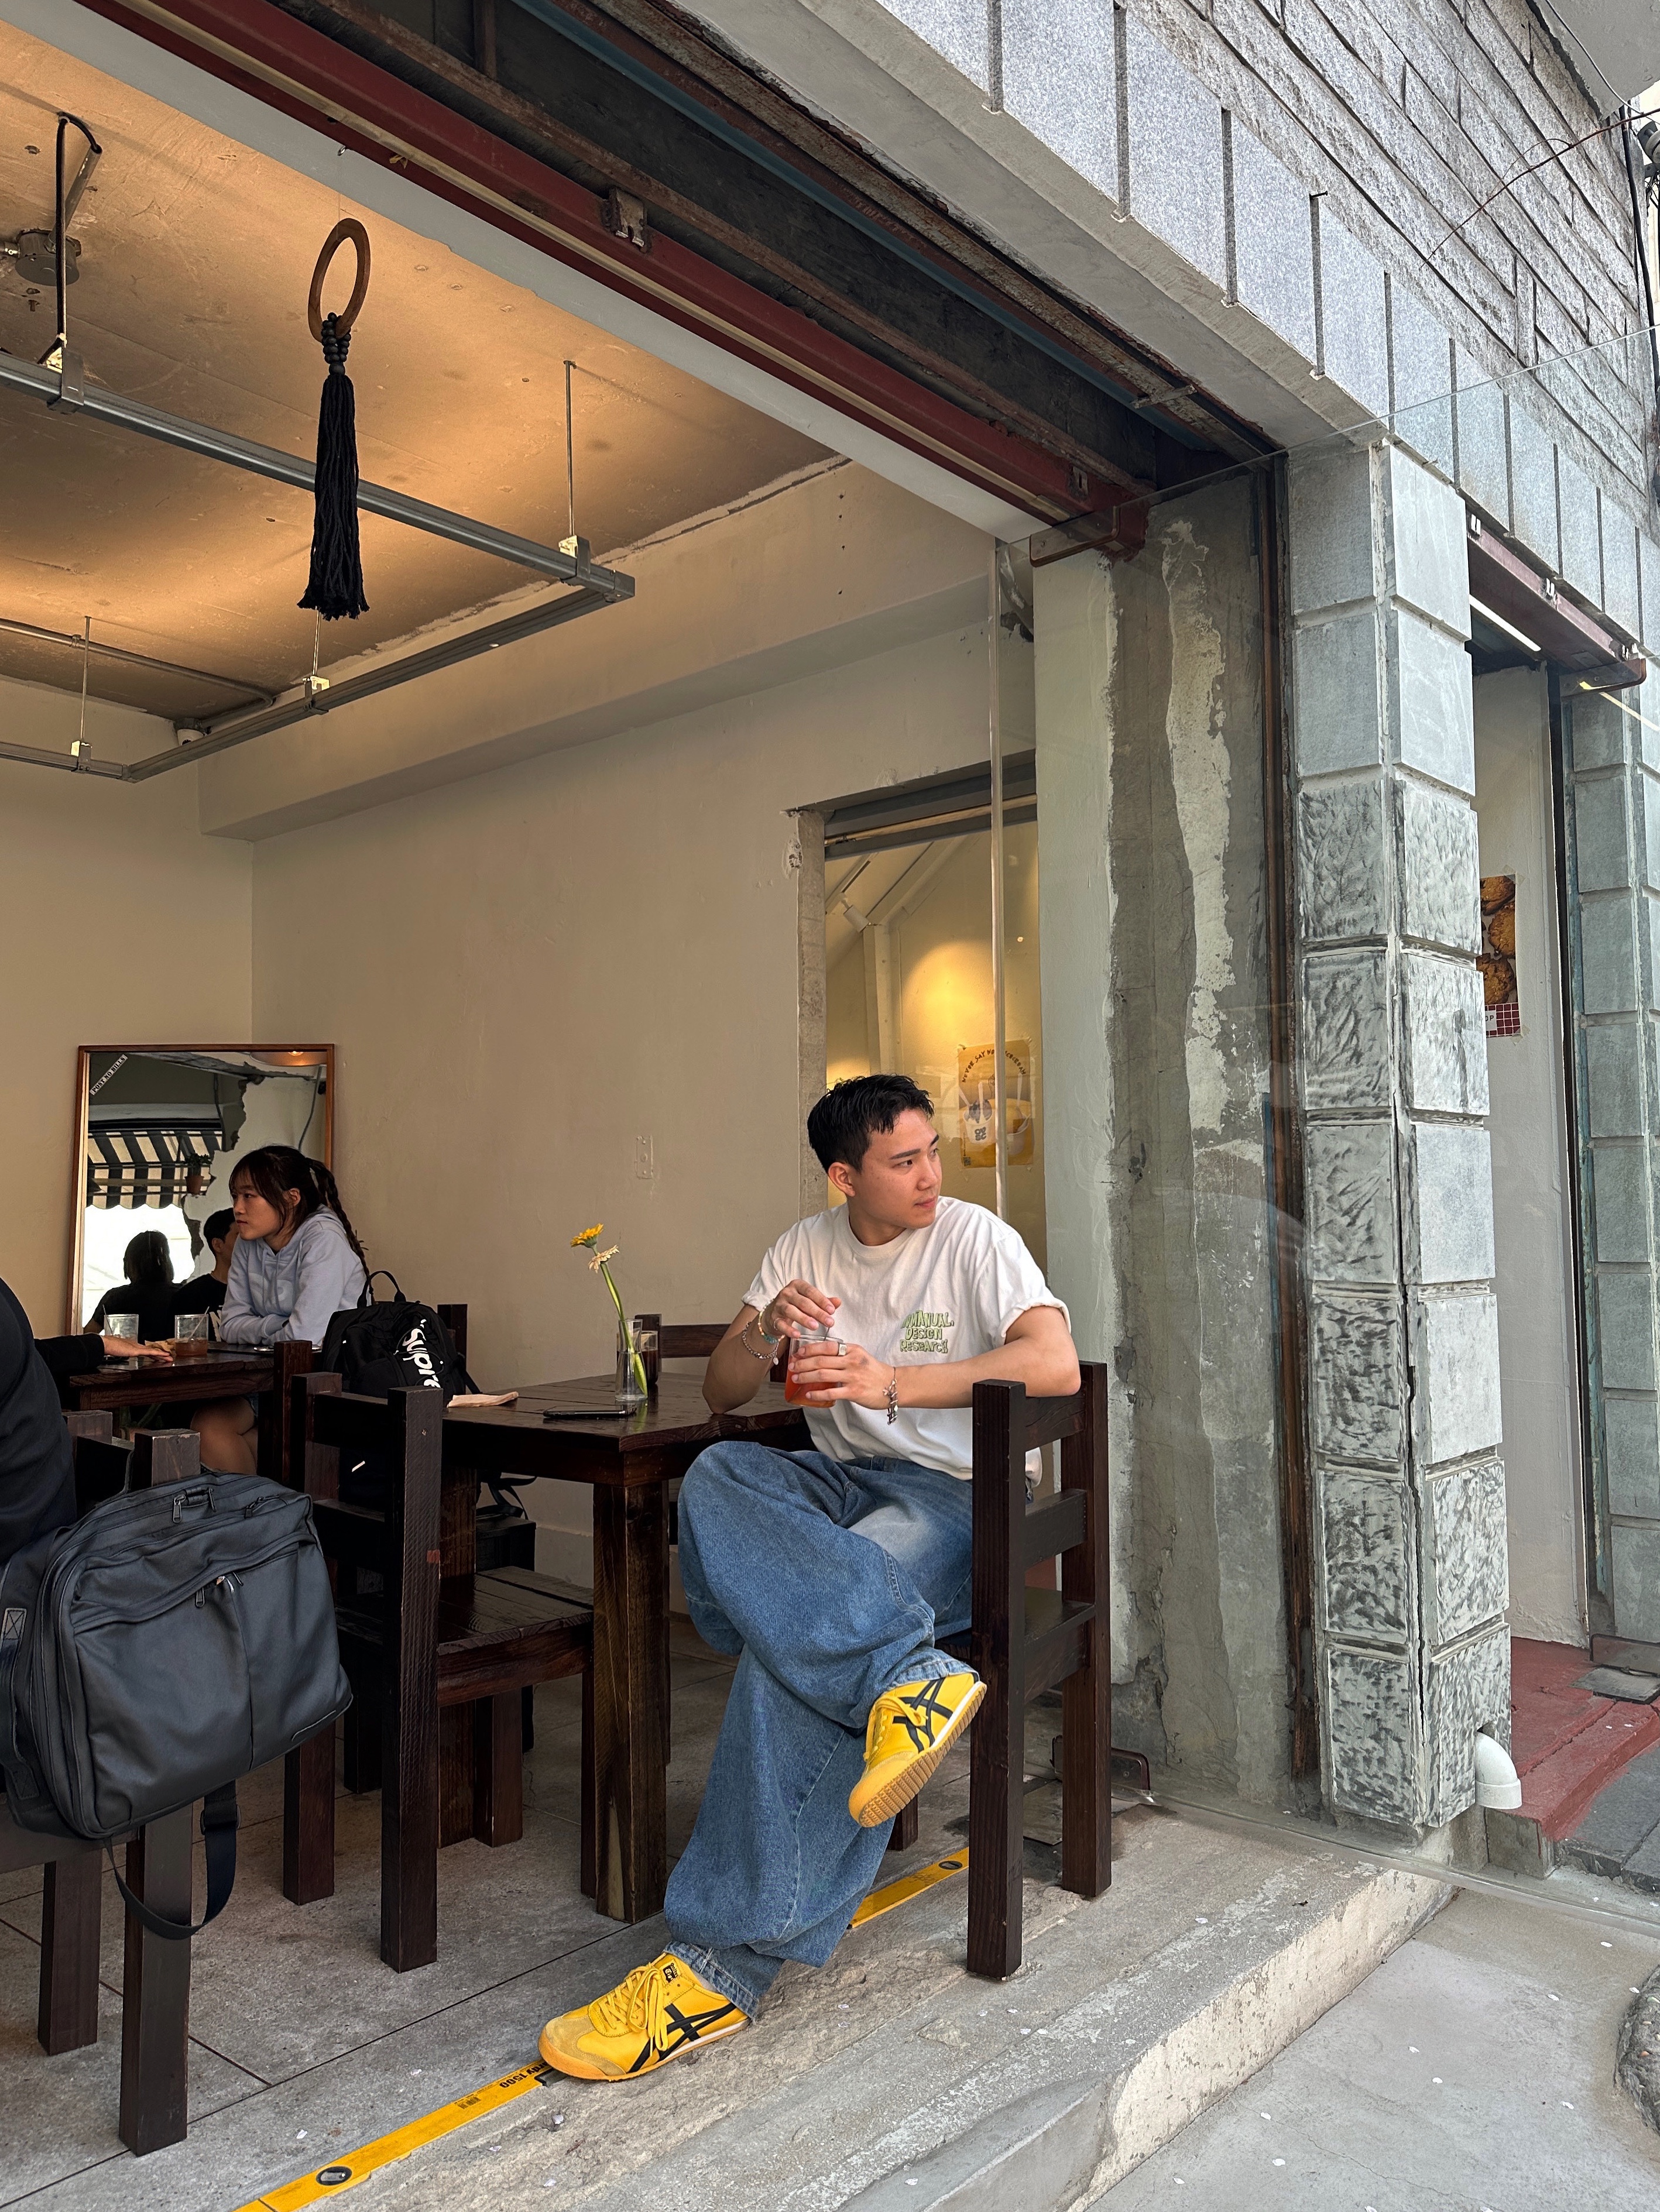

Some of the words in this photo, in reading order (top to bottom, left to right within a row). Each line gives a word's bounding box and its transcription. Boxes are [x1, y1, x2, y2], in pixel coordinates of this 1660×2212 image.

[975, 1050, 985, 1063] SAY
[92, 1078, 105, 1093] POST
[104, 1071, 112, 1080] NO
[111, 1057, 125, 1072] BILLS
[906, 1327, 942, 1340] DESIGN
[499, 2073, 528, 2089] 1500
